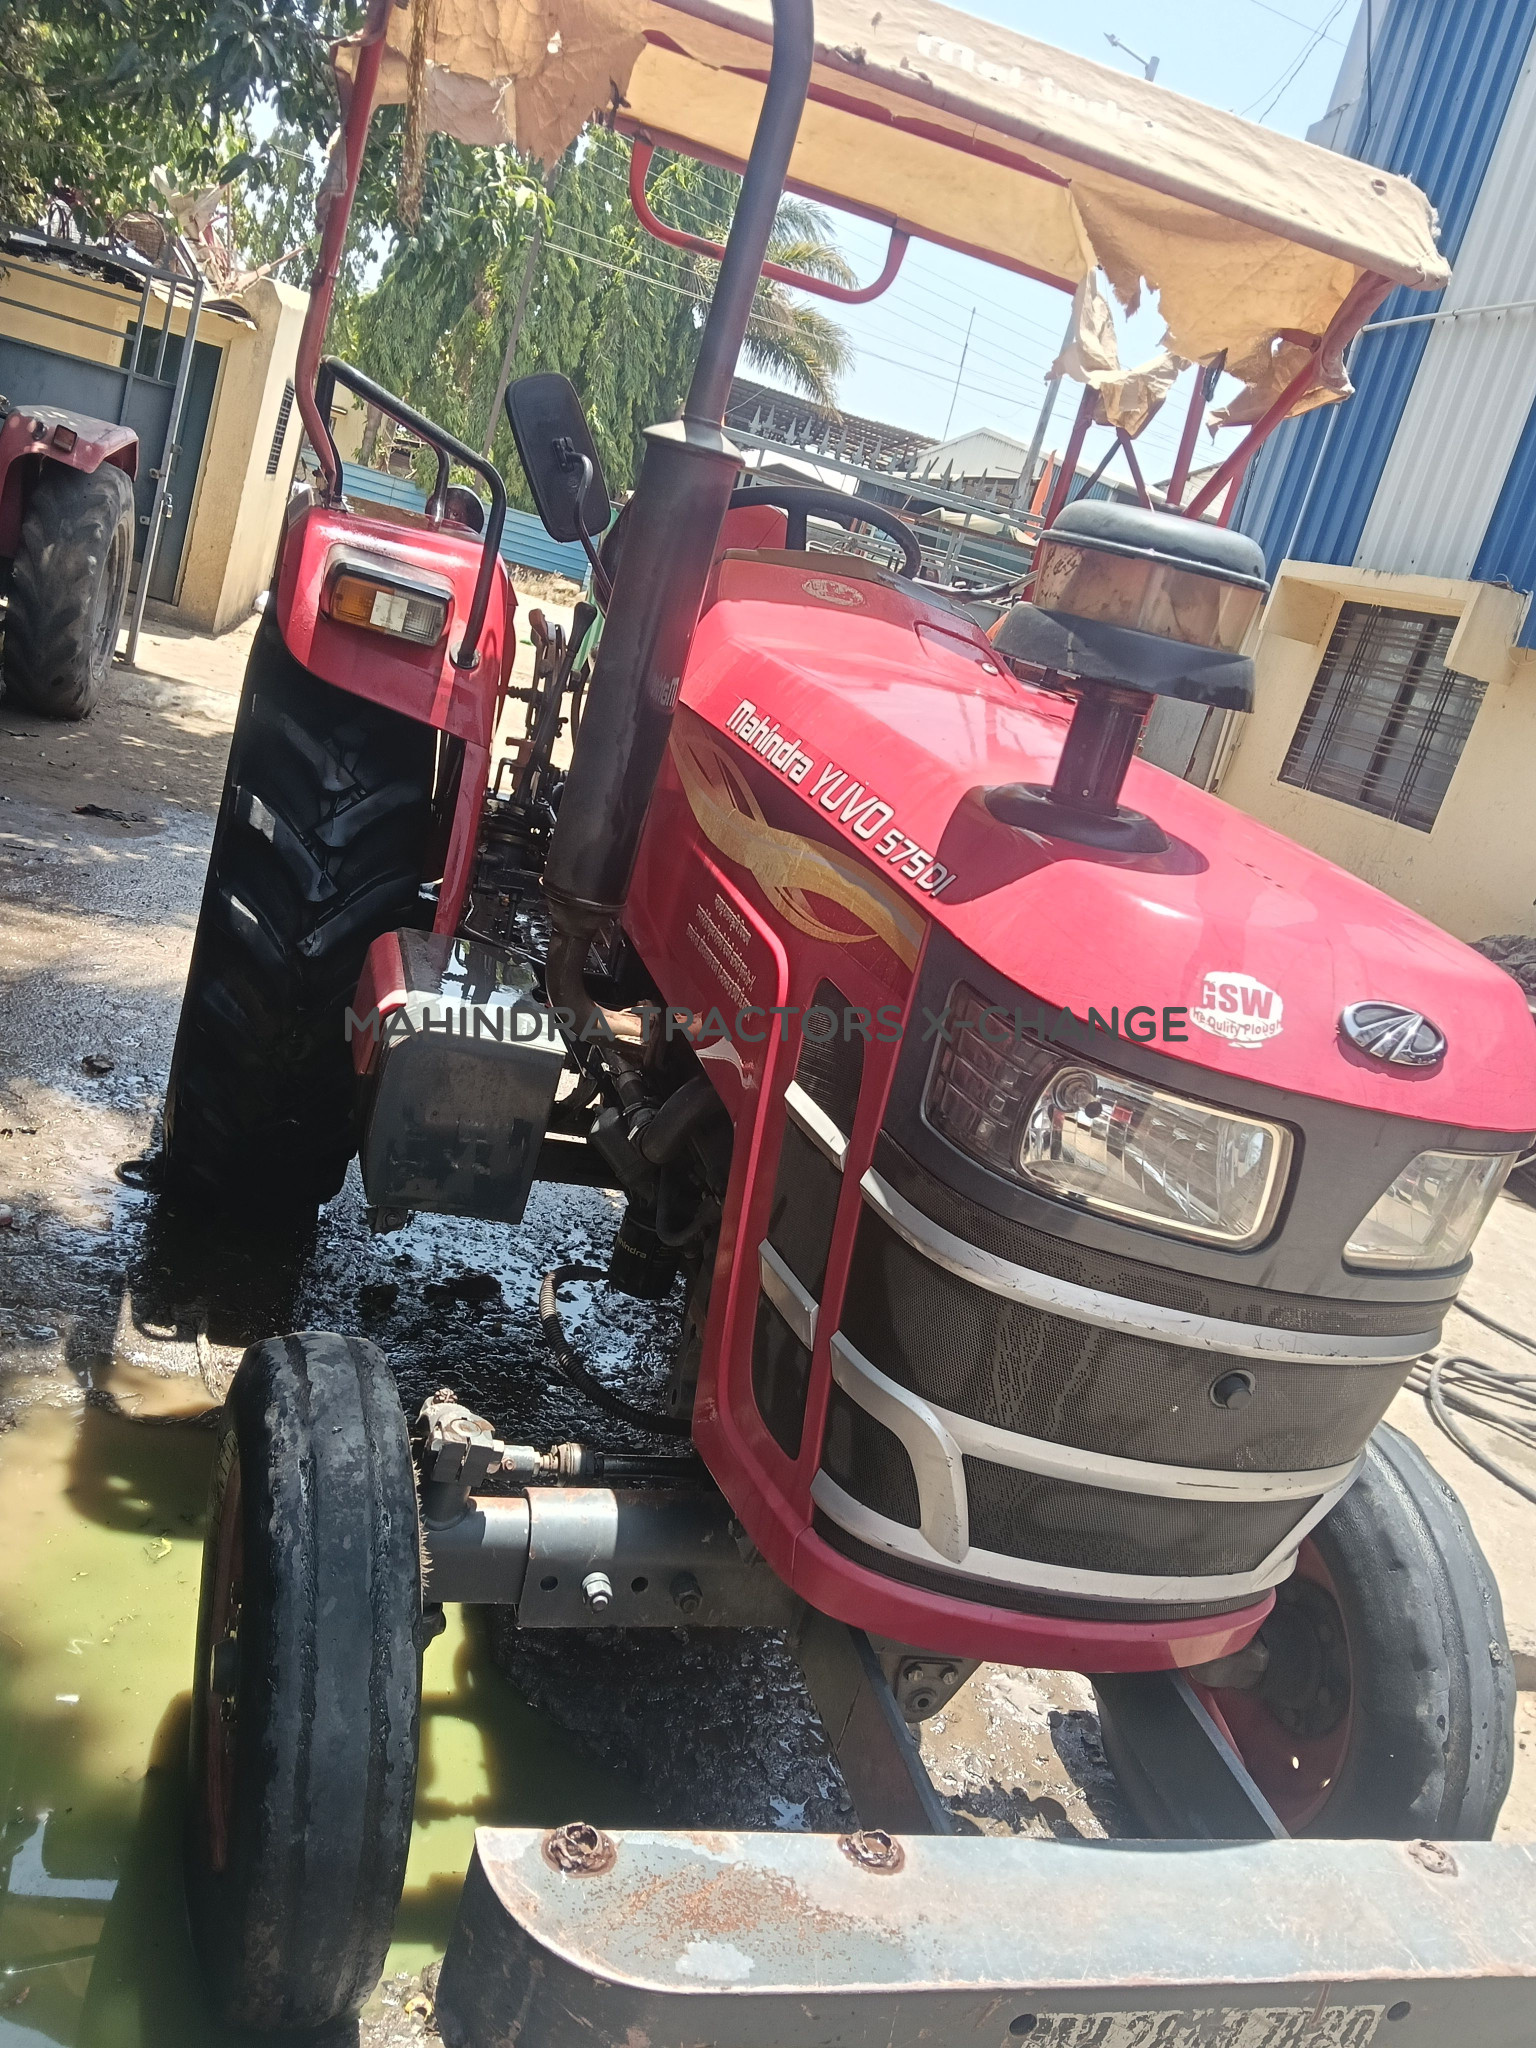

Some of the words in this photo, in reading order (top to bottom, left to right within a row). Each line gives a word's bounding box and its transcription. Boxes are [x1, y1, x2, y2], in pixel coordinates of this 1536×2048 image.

[726, 698, 815, 785] Mahindra
[808, 762, 895, 840] YUVO
[873, 827, 957, 898] 575DI
[1200, 980, 1274, 1020] GSW
